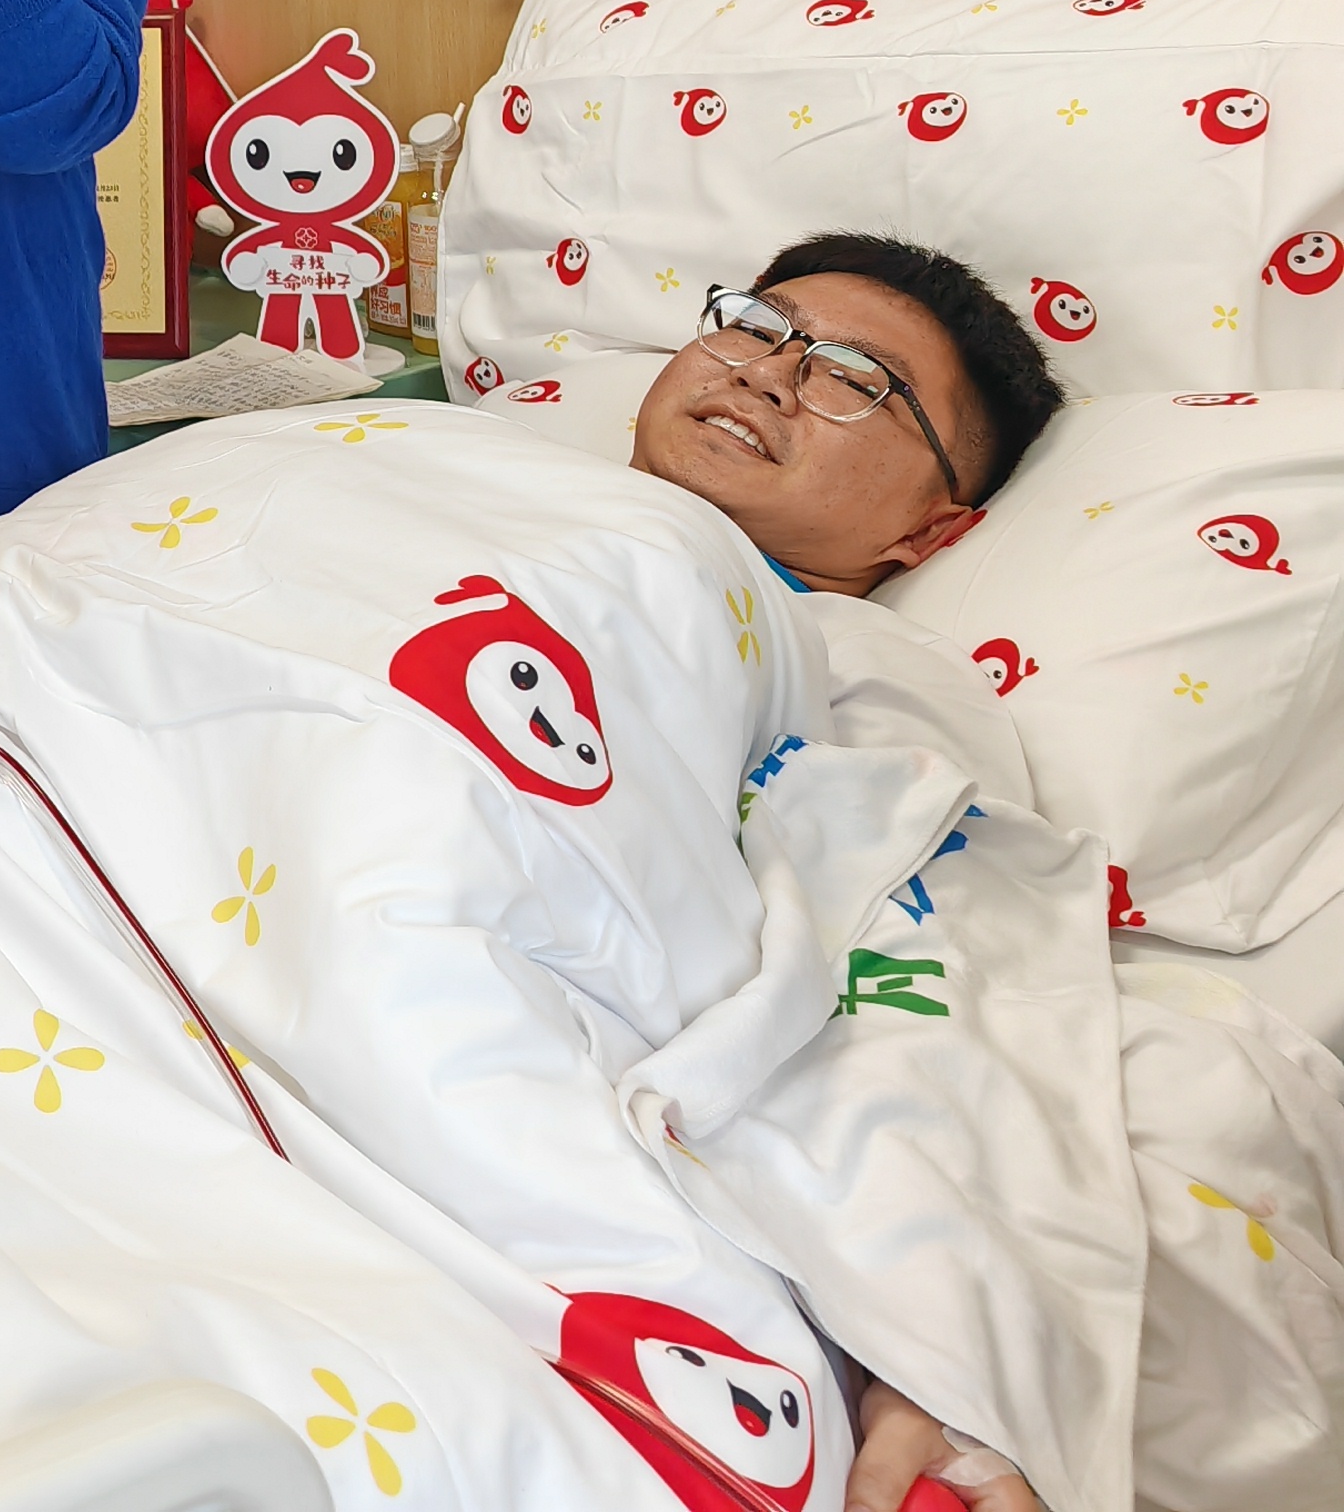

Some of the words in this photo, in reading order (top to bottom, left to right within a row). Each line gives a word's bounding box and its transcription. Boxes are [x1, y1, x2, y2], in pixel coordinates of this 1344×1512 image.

[289, 254, 325, 270] 寻找
[266, 269, 351, 291] 生命的种子
